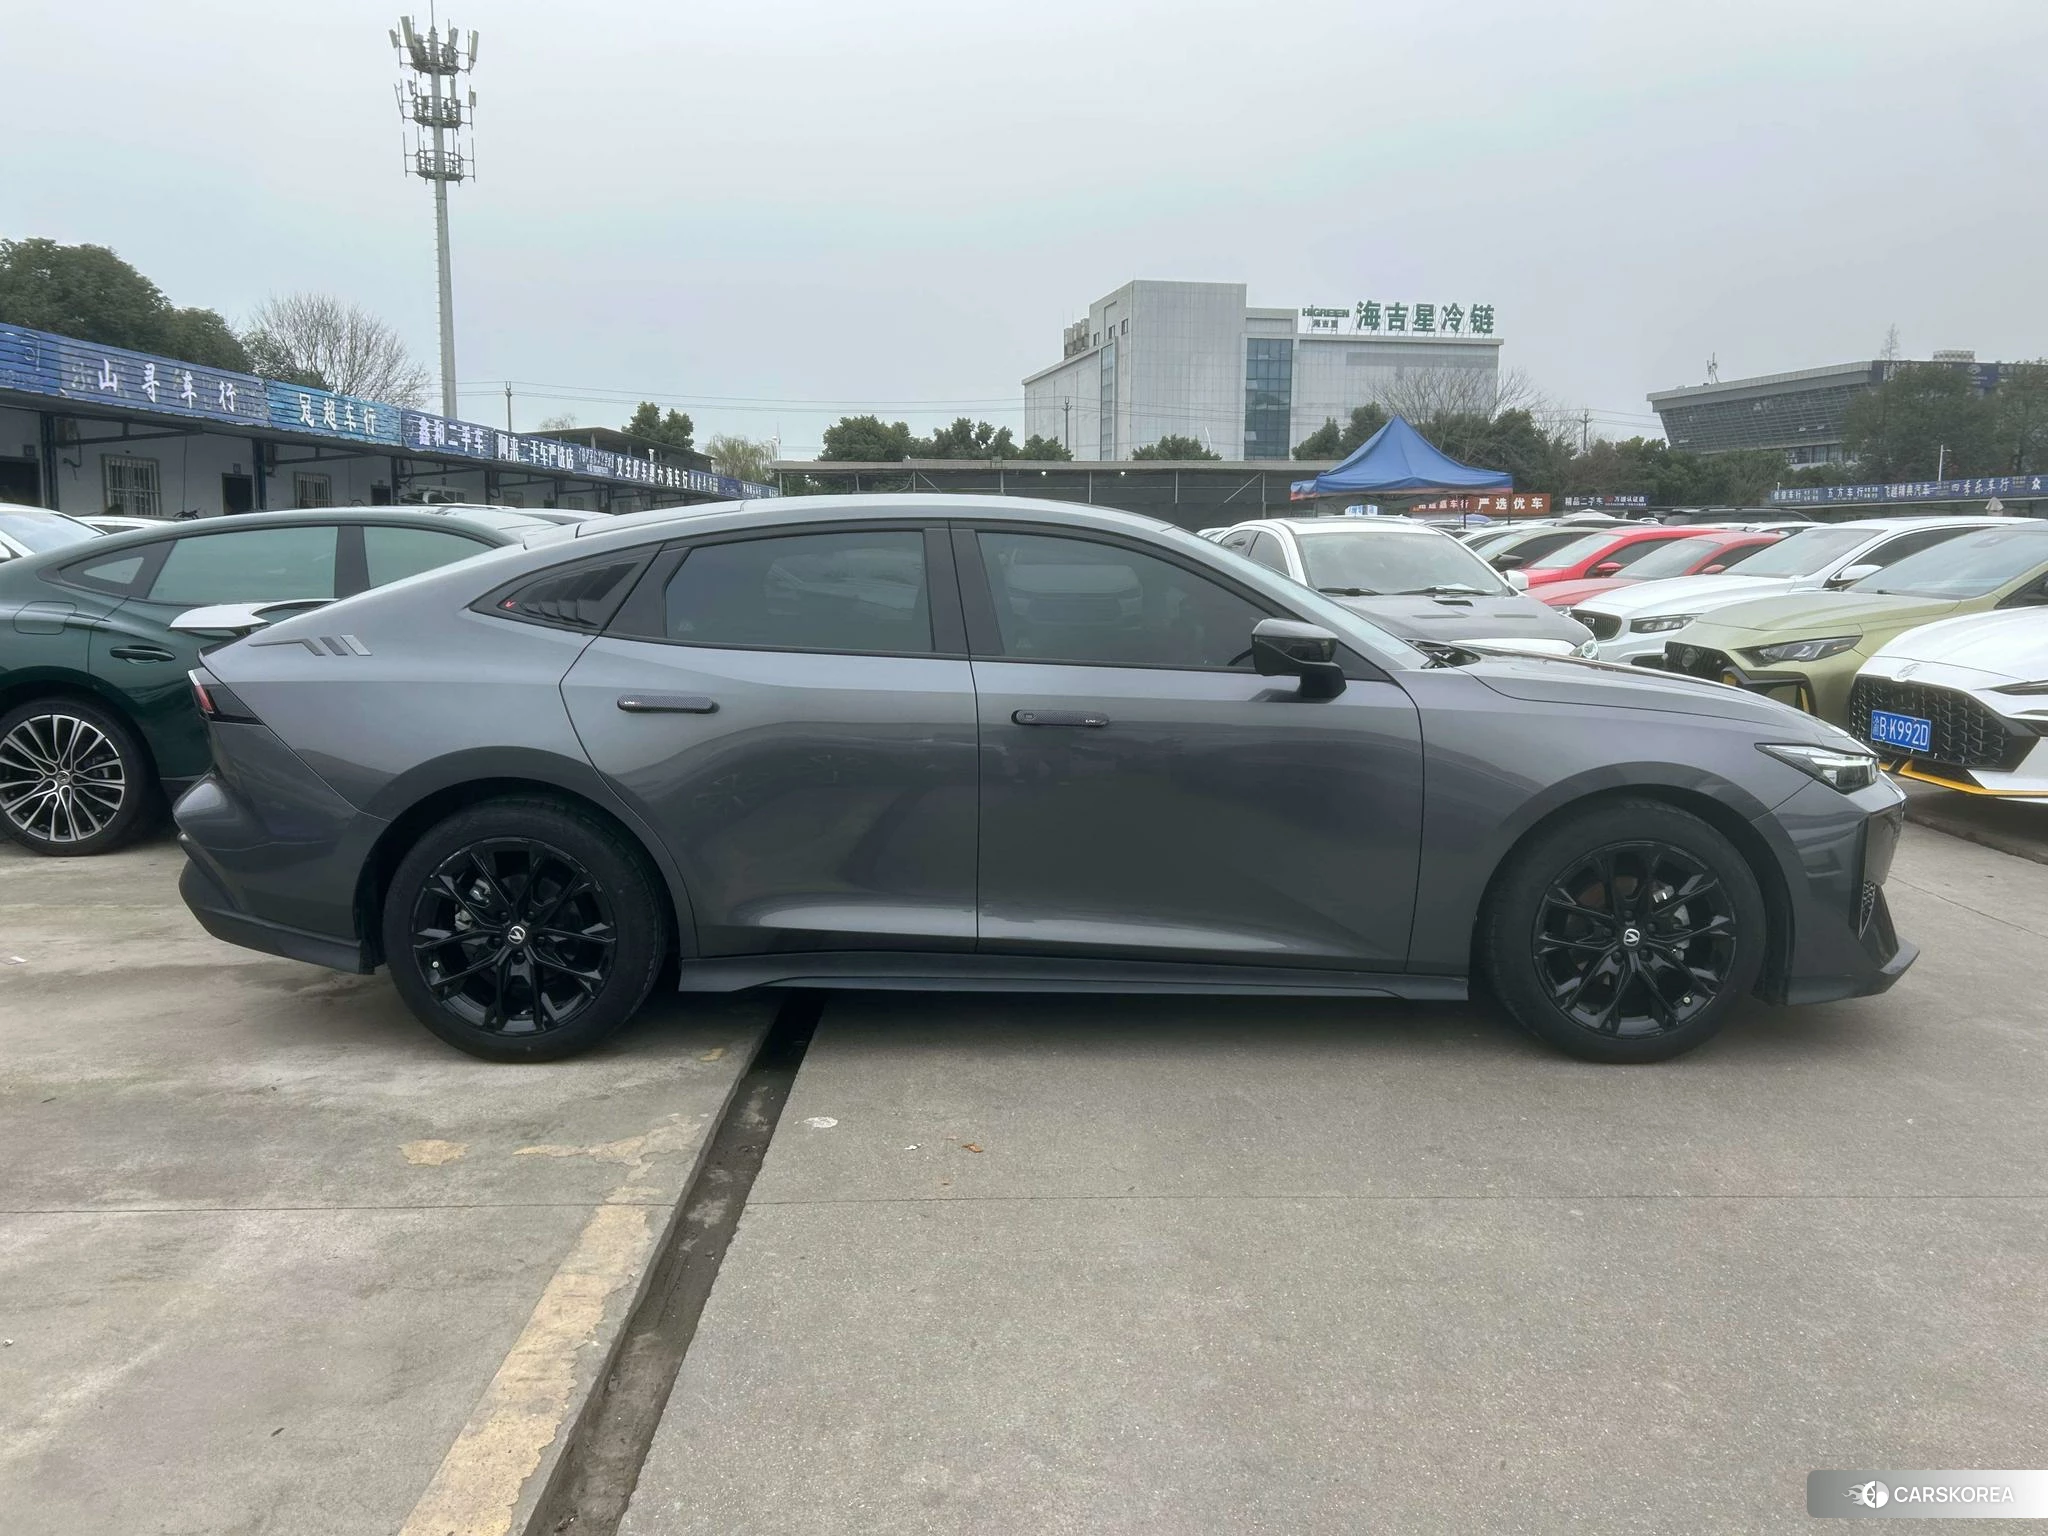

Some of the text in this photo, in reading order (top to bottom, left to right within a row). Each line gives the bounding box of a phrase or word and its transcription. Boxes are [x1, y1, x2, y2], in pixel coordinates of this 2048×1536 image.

[1356, 300, 1495, 334] 海吉星冷链
[418, 416, 484, 455] 鑫和二手车
[1478, 497, 1544, 510] 严选优车
[1827, 486, 1864, 498] 五方车行
